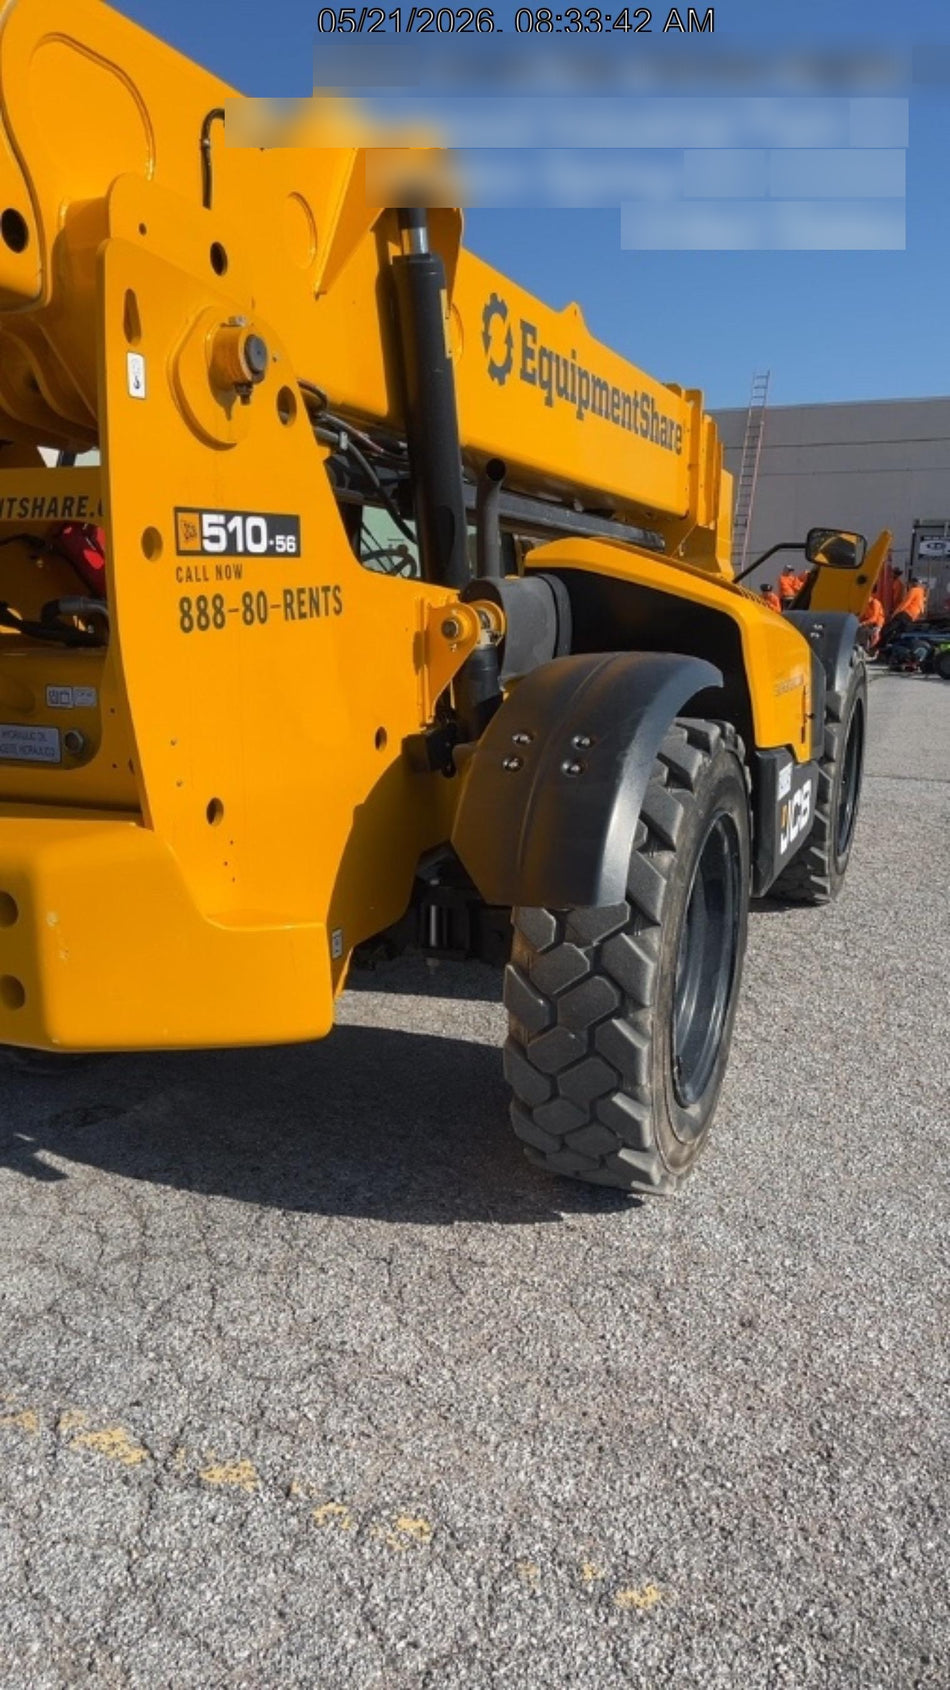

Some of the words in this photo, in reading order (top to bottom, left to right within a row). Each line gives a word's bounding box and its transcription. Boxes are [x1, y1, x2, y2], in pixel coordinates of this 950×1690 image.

[519, 318, 684, 456] EquipmentShare
[176, 566, 209, 583] CALL
[215, 563, 243, 581] NOW
[179, 584, 343, 634] 888-80-RENTS
[780, 779, 812, 855] JCB
